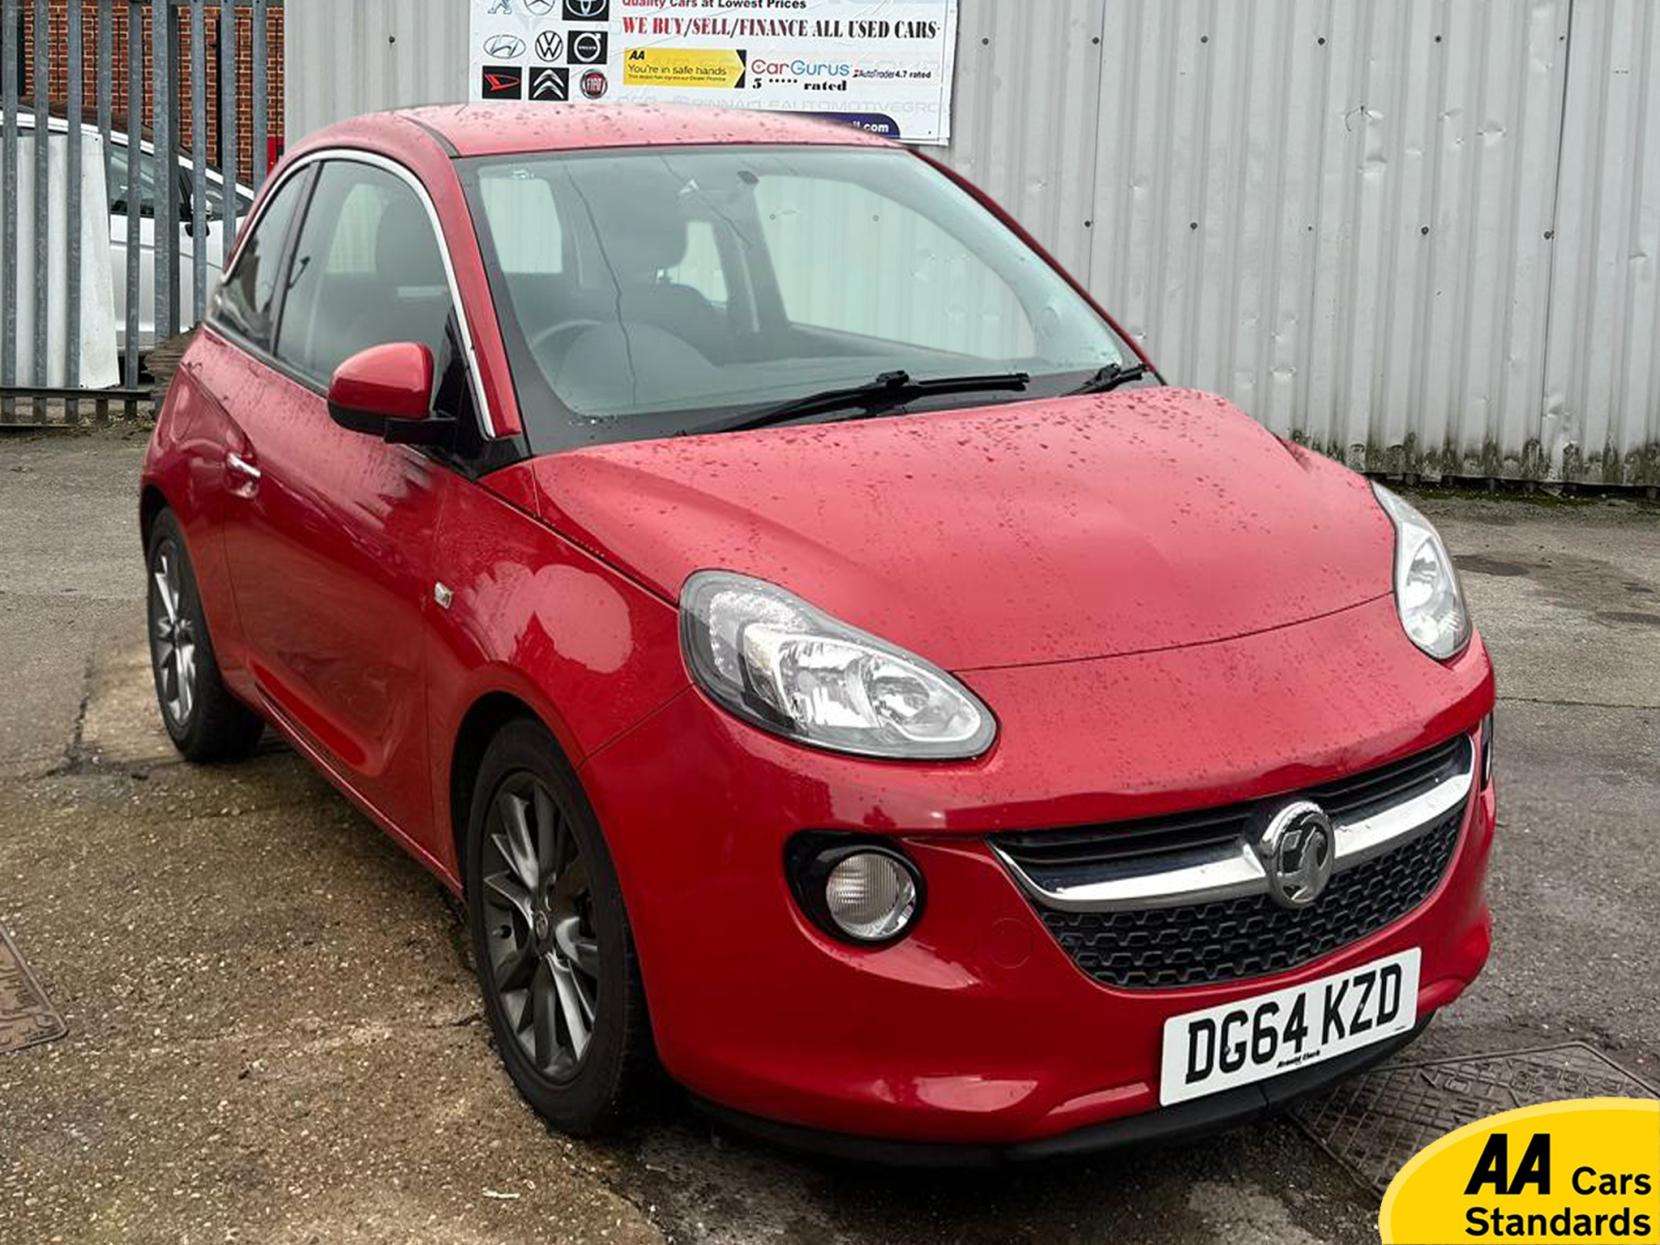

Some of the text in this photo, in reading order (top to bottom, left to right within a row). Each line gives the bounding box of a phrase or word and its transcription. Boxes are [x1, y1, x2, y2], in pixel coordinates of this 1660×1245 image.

[622, 0, 665, 9] Quality
[701, 0, 714, 8] at
[717, 0, 762, 8] Lowest
[766, 0, 807, 9] Prices
[622, 16, 937, 39] WE BUY/SELL/FINANCE ALL USED CARS
[629, 50, 645, 60] AA
[628, 64, 727, 76] You're in safe hands
[751, 59, 850, 77] CarGurus
[909, 70, 931, 79] rated
[804, 80, 847, 91] rated
[1185, 963, 1402, 1085] DG64 KZD
